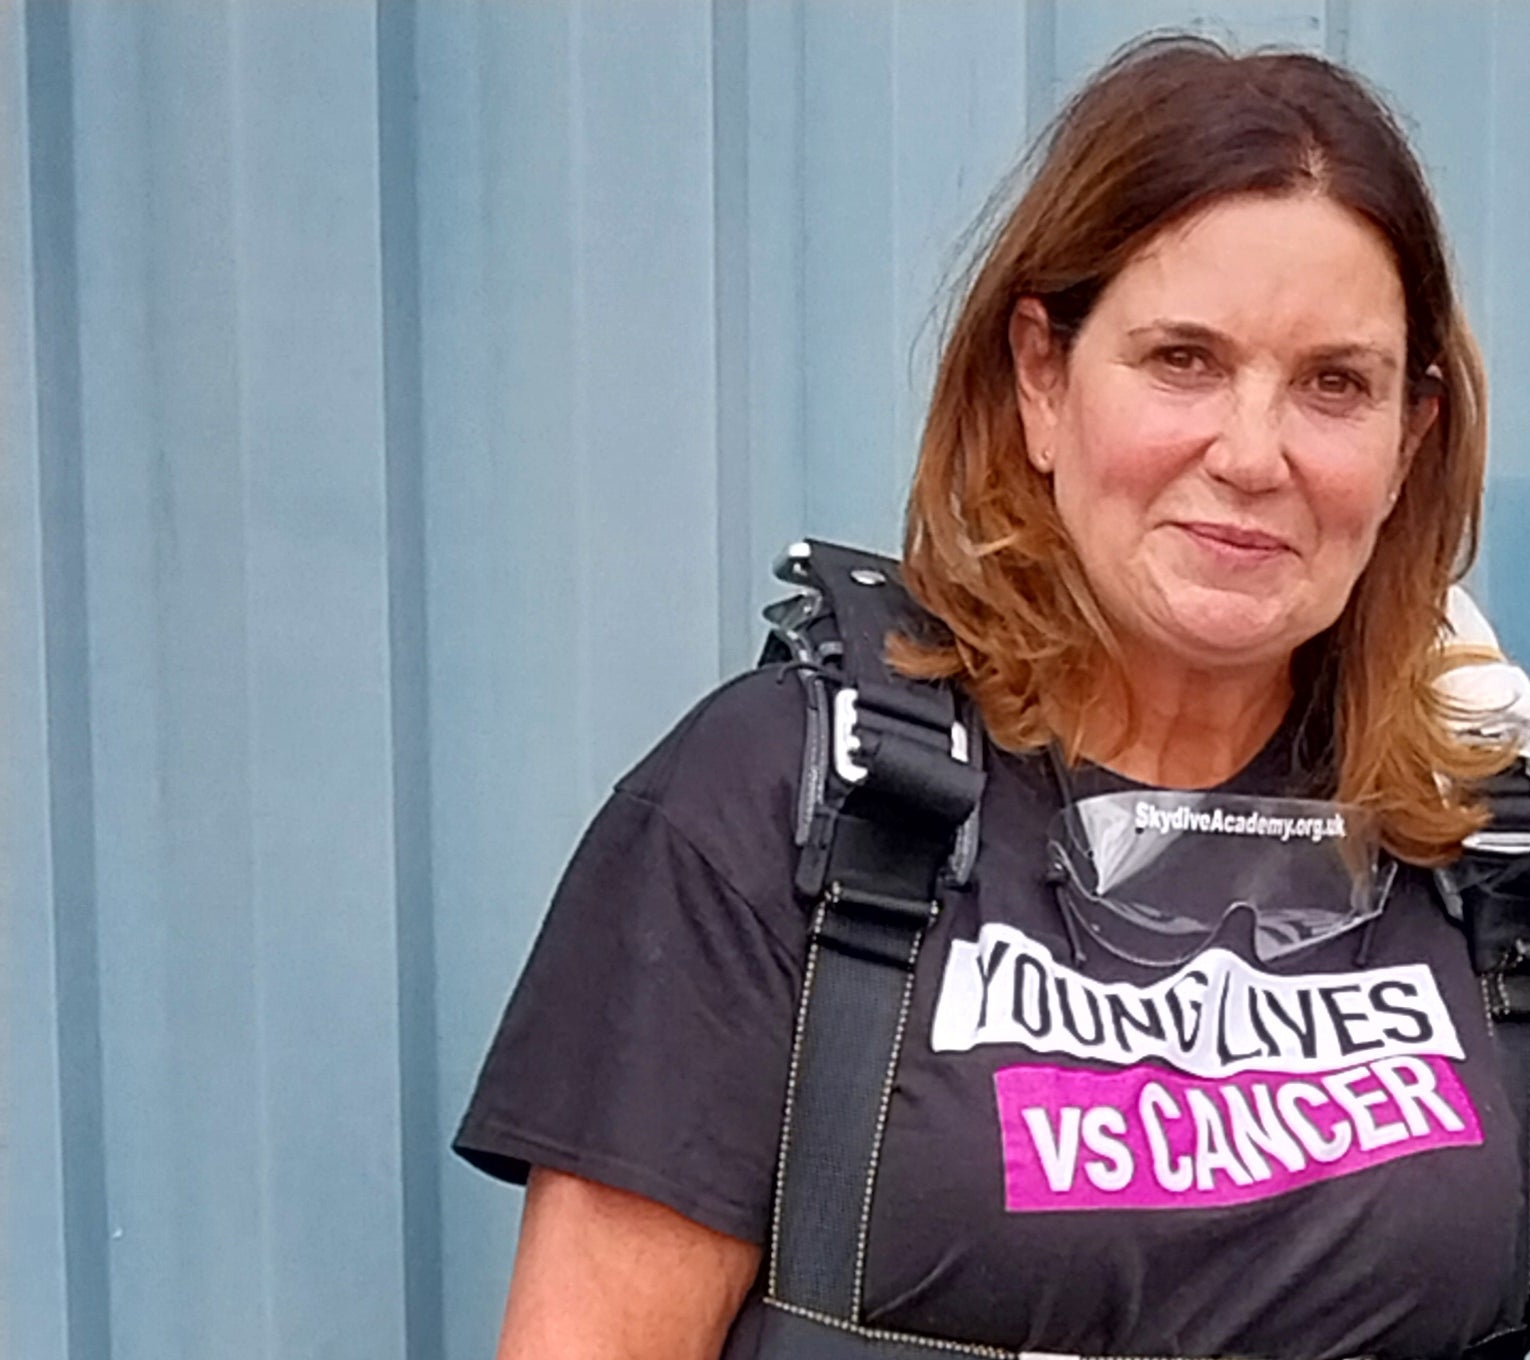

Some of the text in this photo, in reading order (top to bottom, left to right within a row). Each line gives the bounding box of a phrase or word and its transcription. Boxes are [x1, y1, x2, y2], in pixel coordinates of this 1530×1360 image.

[1135, 801, 1345, 842] SkydiveAcademy.org.uk
[976, 941, 1435, 1066] YOUNG LIVES
[1022, 1055, 1465, 1192] VS CANCER
